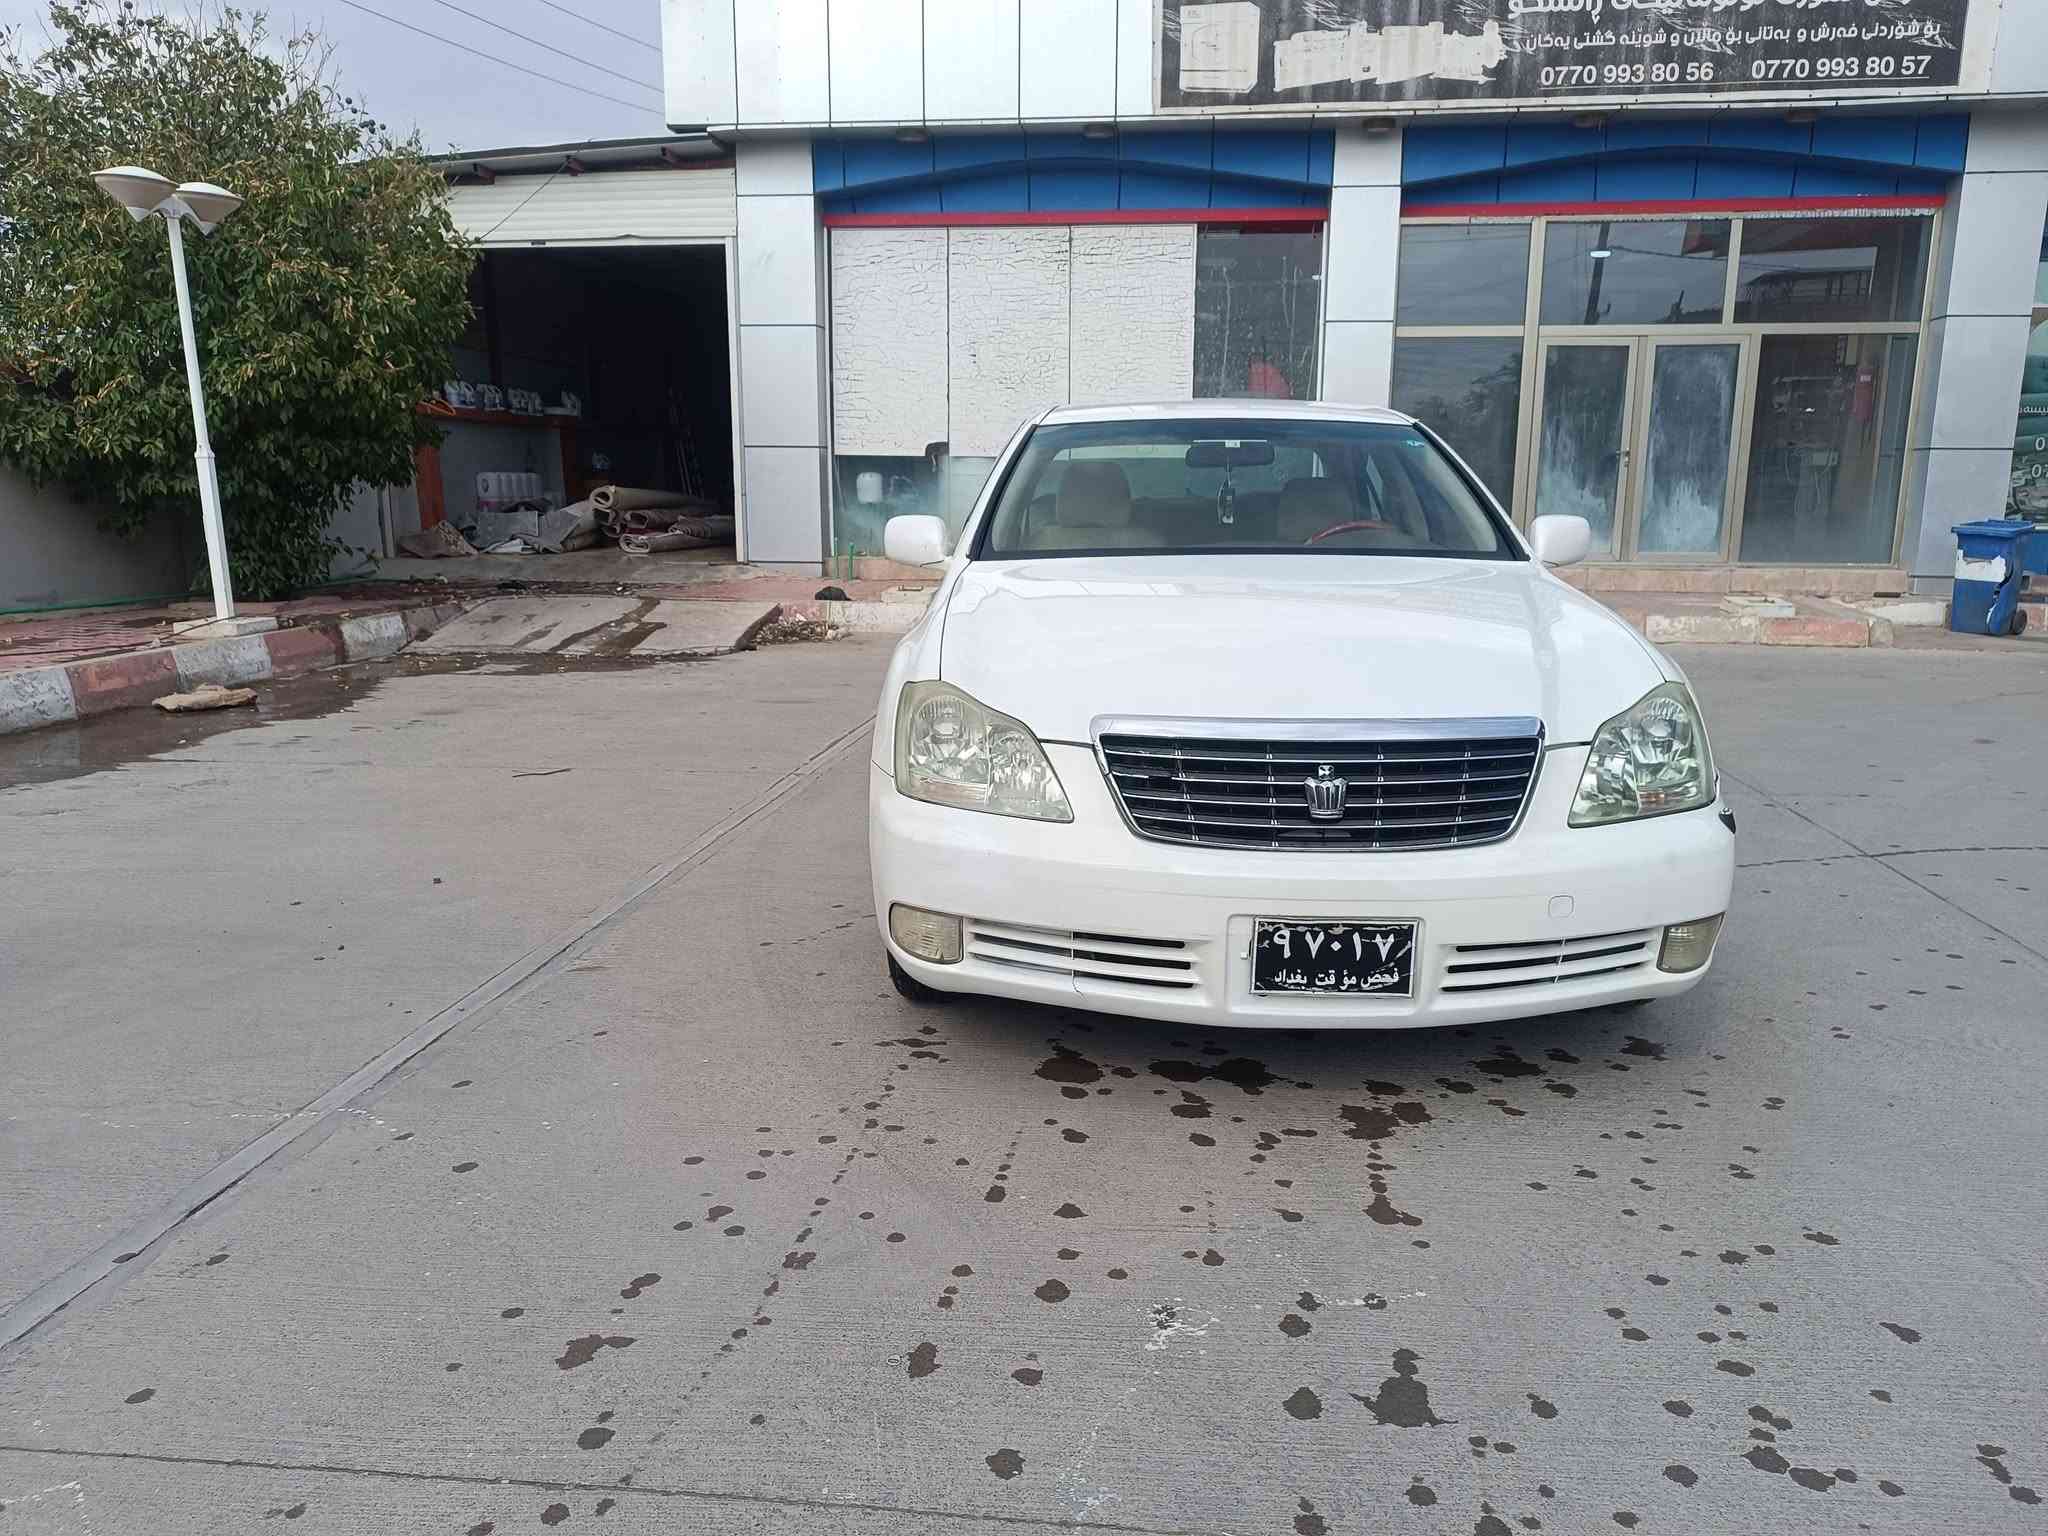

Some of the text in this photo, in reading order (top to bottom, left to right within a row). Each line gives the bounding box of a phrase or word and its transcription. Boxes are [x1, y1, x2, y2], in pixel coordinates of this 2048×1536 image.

[1670, 32, 1680, 47] و
[1797, 28, 1807, 43] و
[1541, 62, 1714, 86] 0770 993 80 56
[1751, 55, 1931, 80] 0770 993 80 57
[1274, 968, 1308, 990] بغداد
